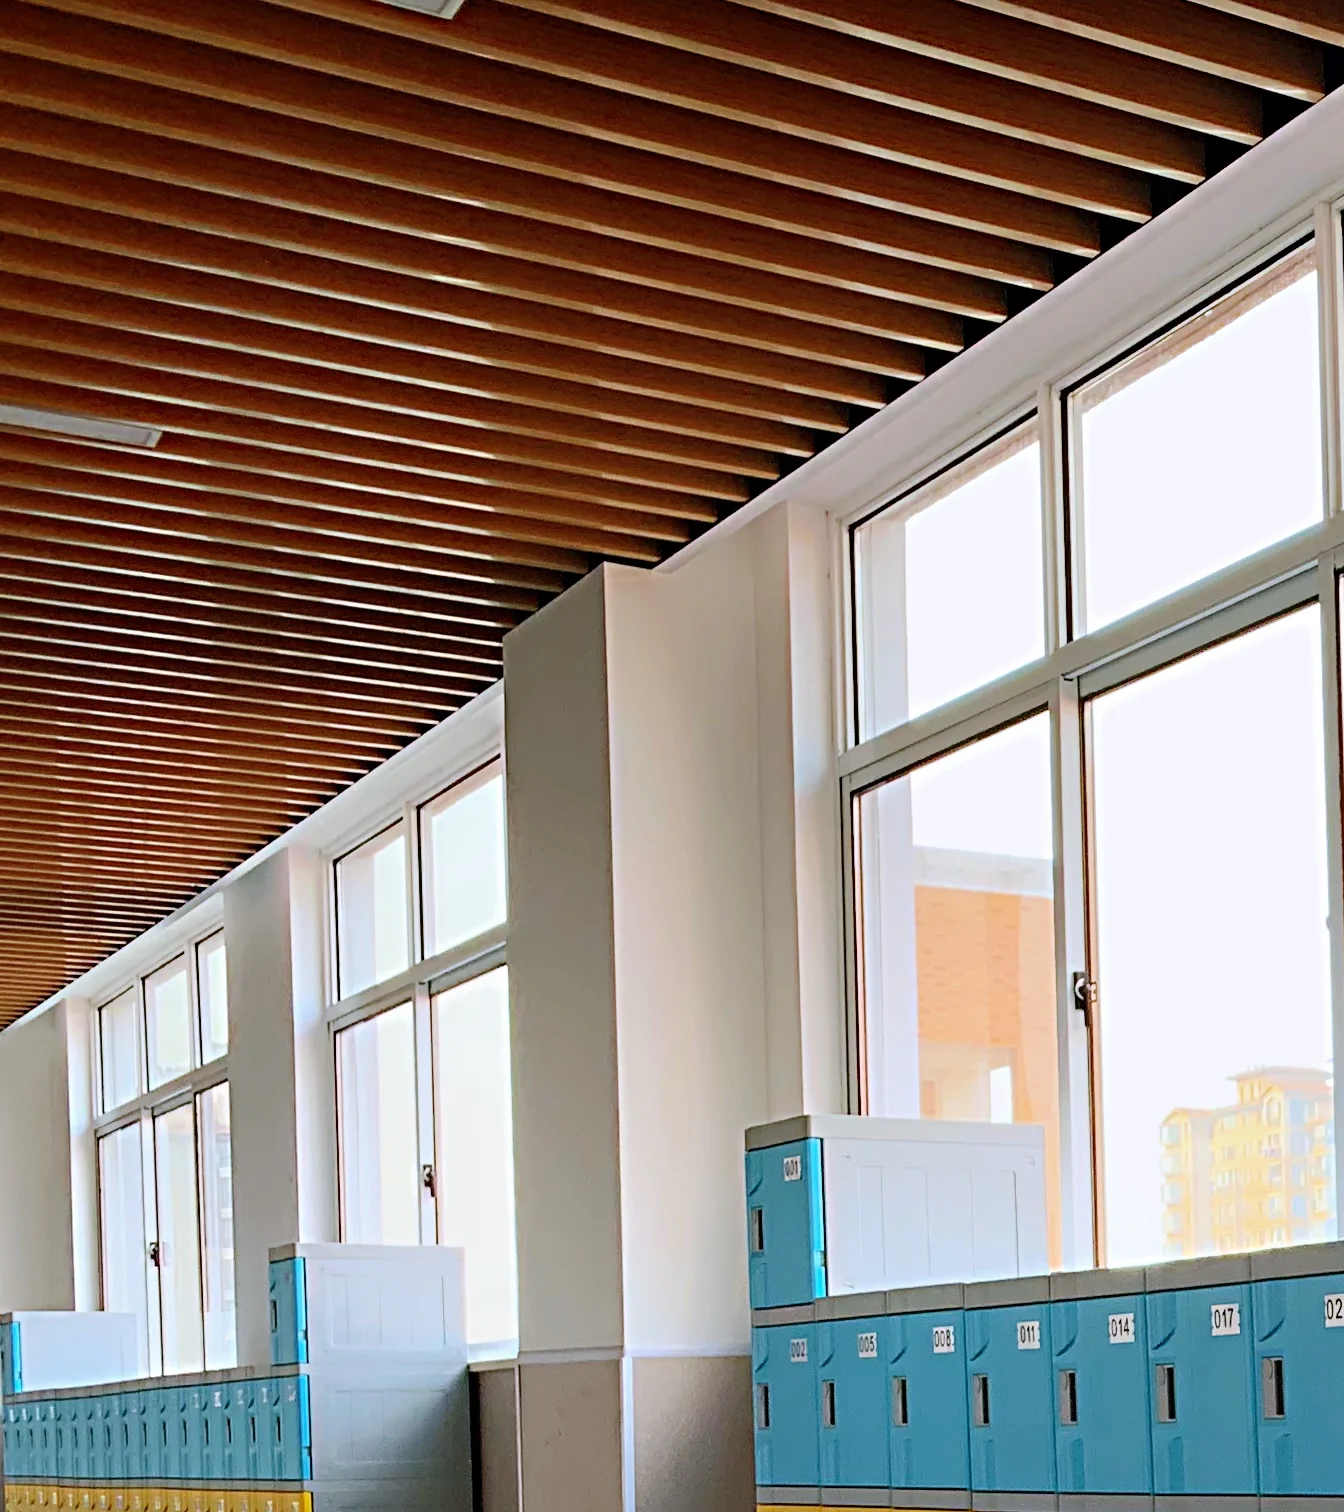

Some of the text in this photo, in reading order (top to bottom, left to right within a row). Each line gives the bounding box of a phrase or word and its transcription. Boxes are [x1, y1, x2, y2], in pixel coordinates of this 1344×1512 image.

[1112, 1318, 1129, 1337] 014
[1215, 1308, 1233, 1329] 017
[935, 1330, 952, 1347] 008
[1020, 1325, 1034, 1343] 011
